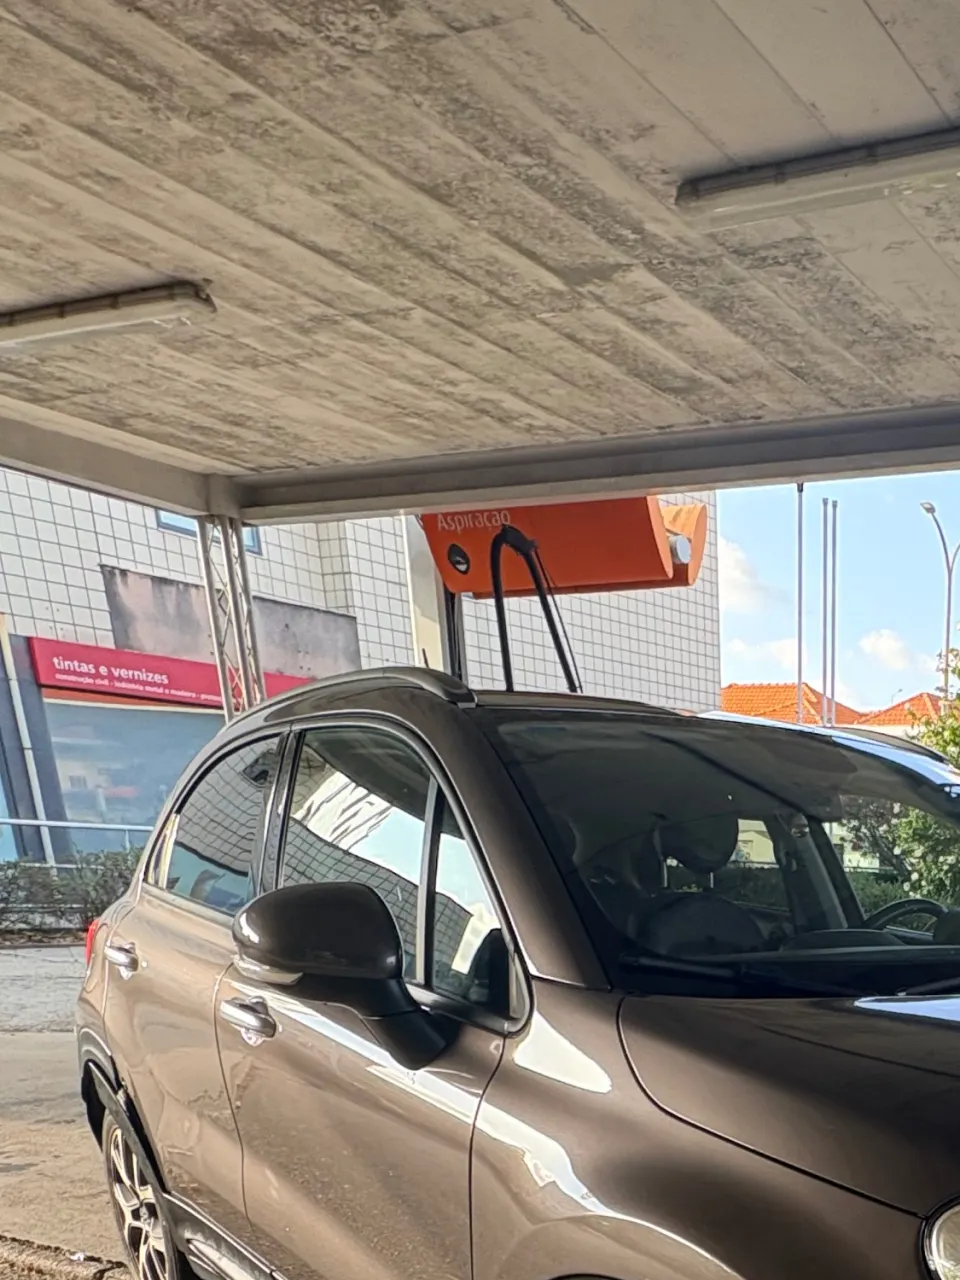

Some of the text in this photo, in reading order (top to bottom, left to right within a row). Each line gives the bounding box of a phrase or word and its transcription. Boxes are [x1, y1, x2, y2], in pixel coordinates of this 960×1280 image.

[52, 656, 169, 684] tintas e vernizes
